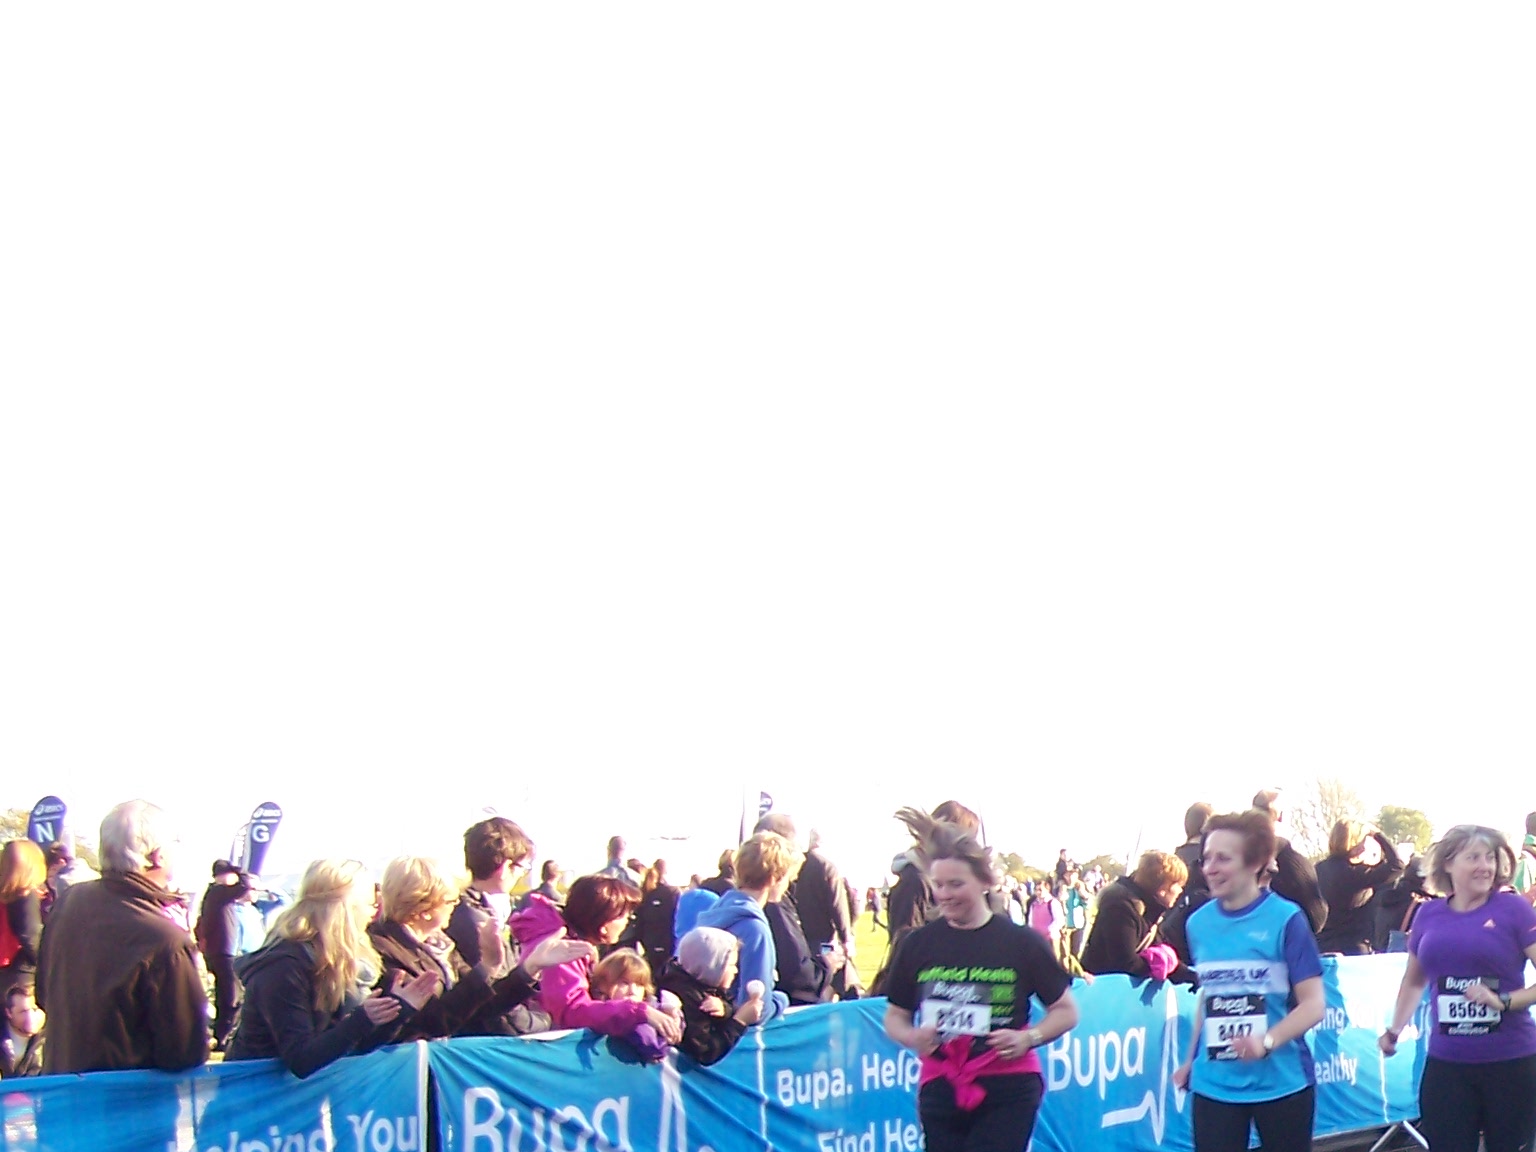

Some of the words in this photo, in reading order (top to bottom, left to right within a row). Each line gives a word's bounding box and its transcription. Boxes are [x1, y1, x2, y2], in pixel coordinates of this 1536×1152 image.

[35, 822, 56, 843] N
[252, 824, 270, 843] G
[1448, 1002, 1488, 1019] 8563
[1047, 1026, 1146, 1101] Bupa
[1314, 1051, 1358, 1086] ealthy
[776, 1066, 853, 1110] Bupa.
[861, 1049, 921, 1093] Help
